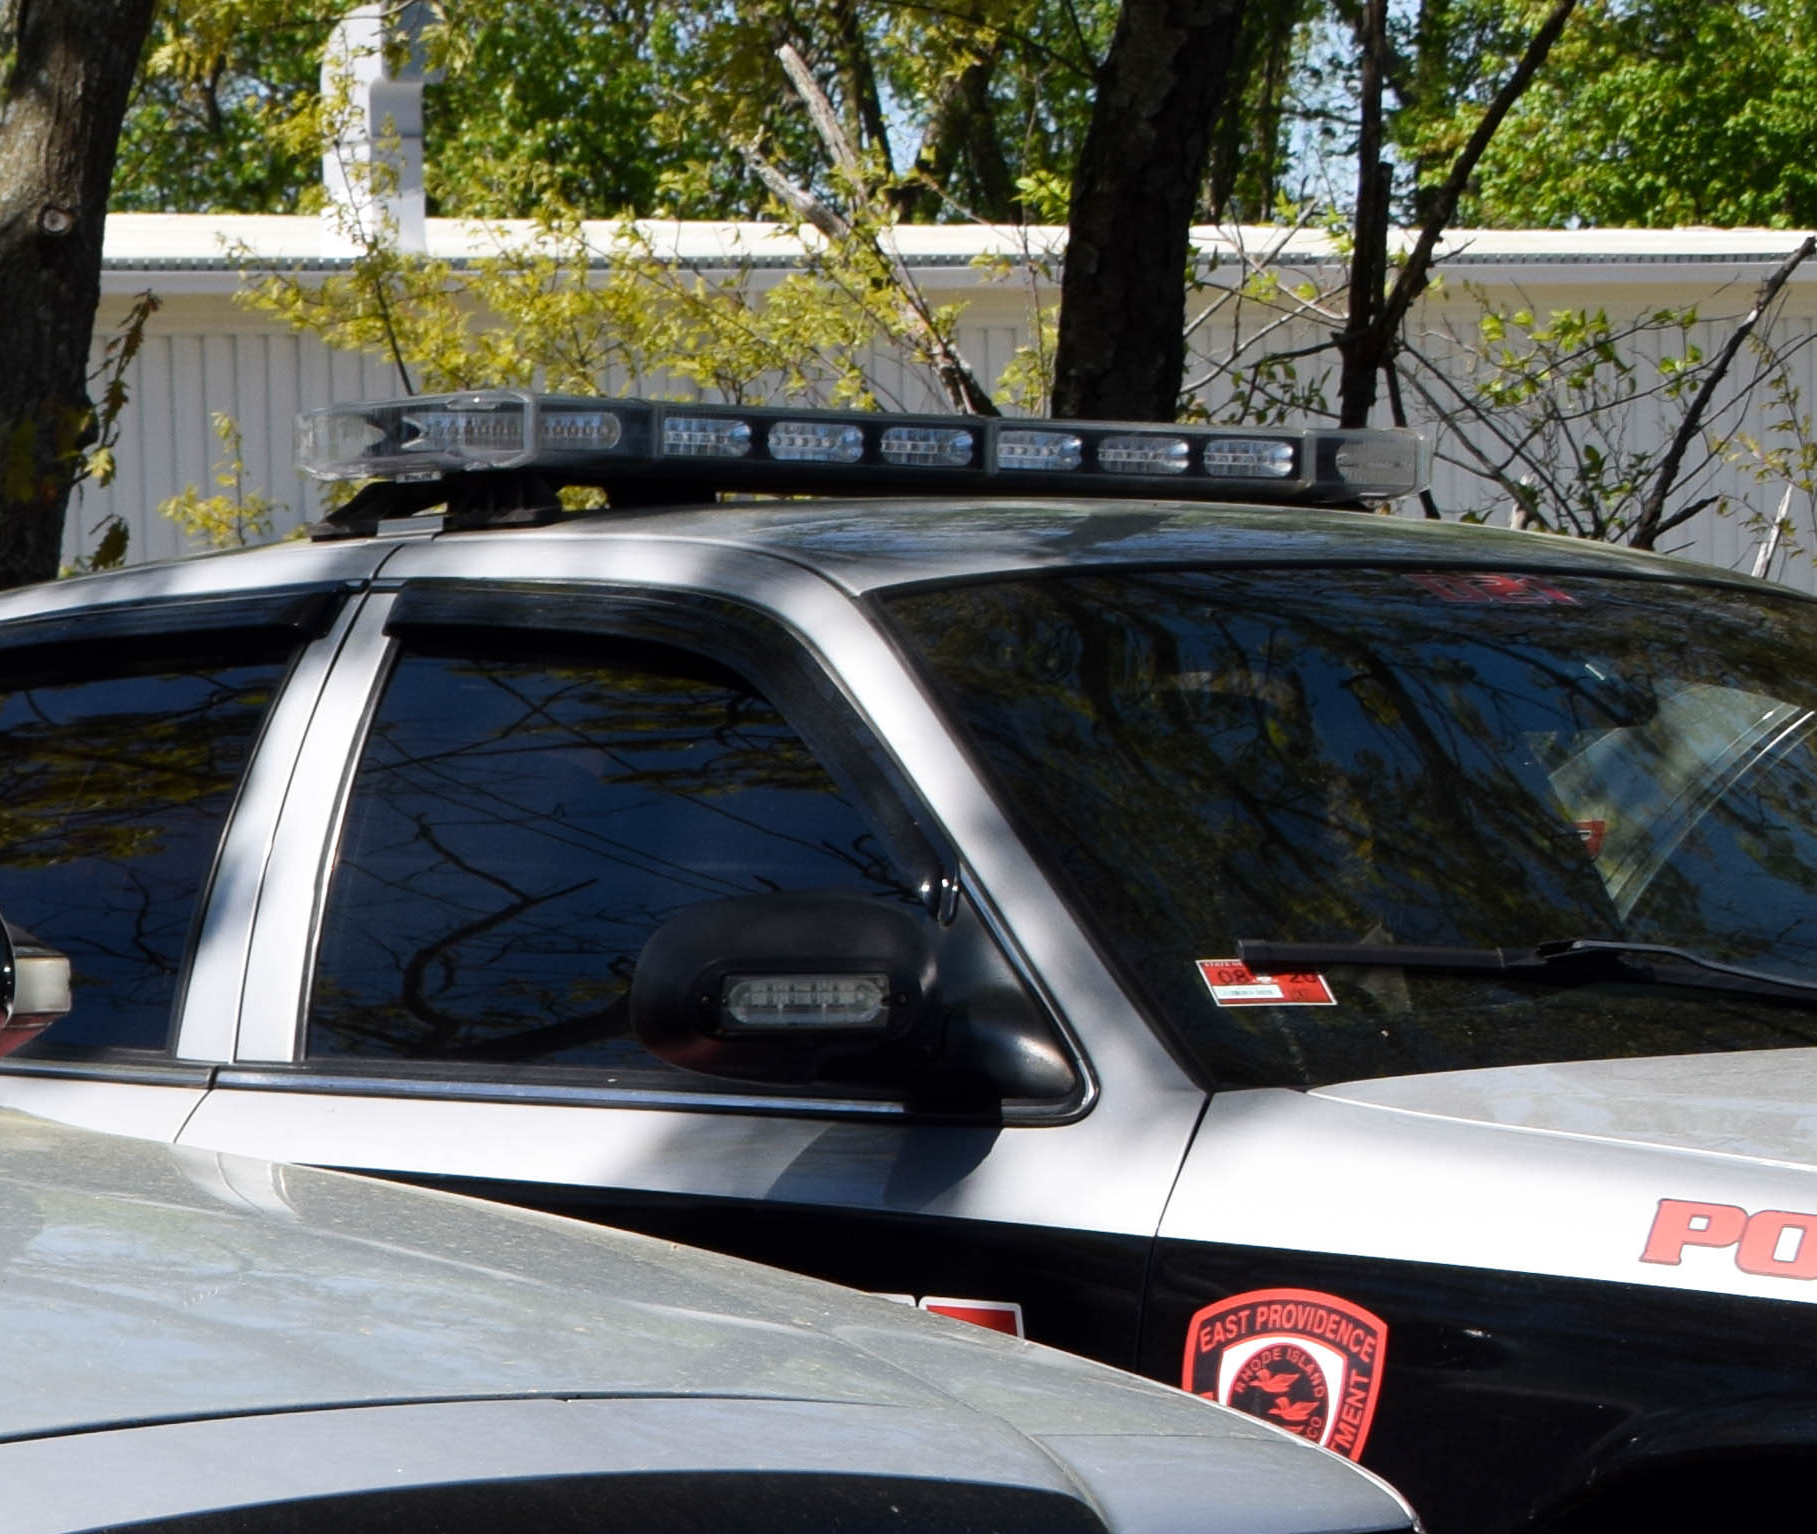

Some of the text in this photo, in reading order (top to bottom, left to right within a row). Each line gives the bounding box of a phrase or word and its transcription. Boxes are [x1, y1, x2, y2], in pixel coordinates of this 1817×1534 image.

[1638, 1198, 1817, 1281] PO
[1199, 1303, 1377, 1363] EAST PROVIDENCE
[1234, 1347, 1327, 1399] RHODE ISLAND
